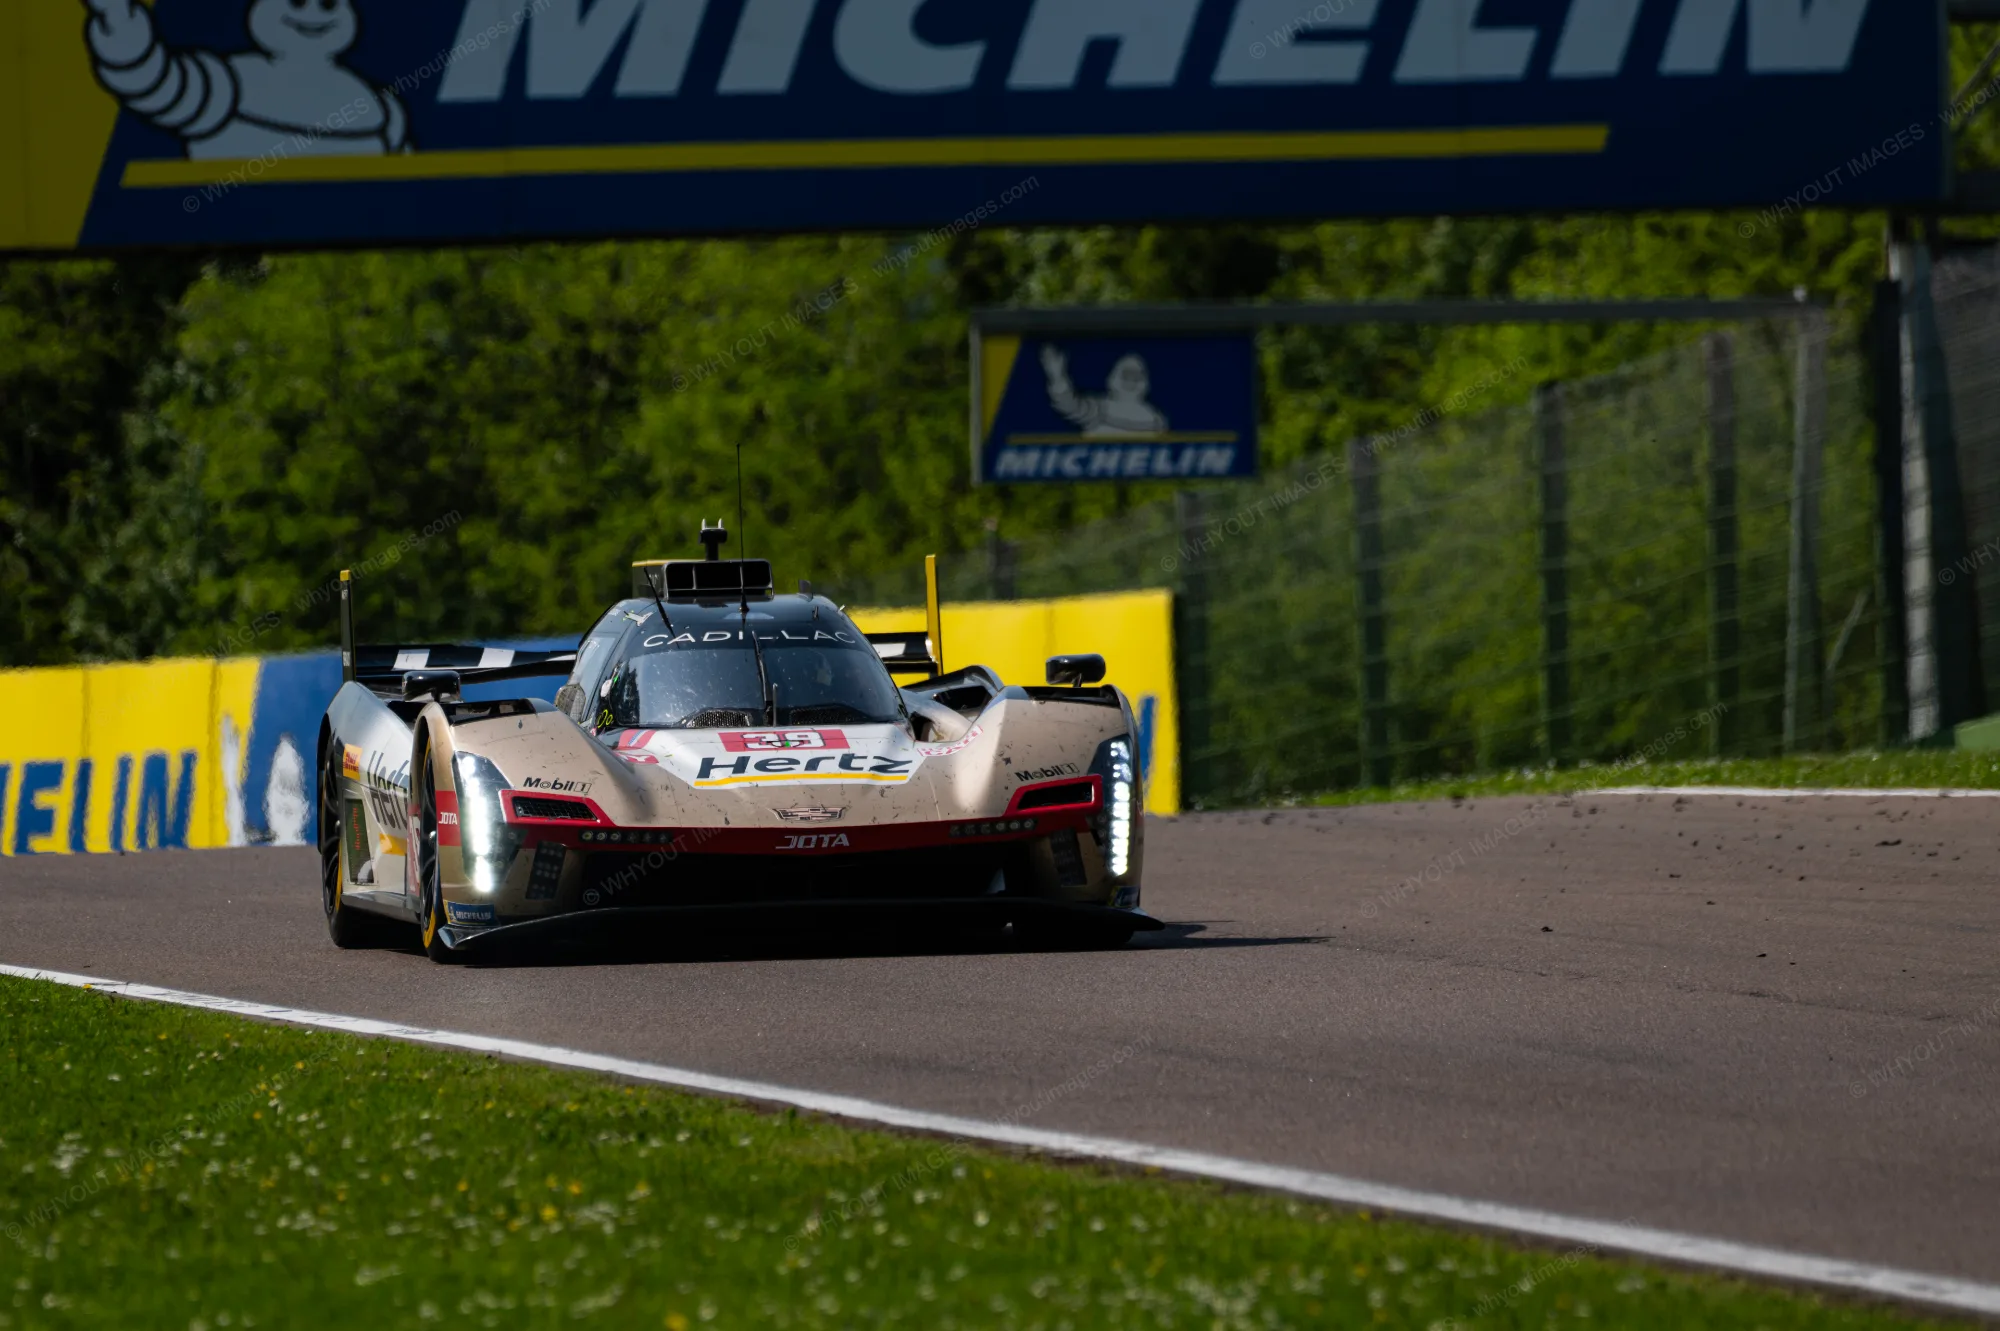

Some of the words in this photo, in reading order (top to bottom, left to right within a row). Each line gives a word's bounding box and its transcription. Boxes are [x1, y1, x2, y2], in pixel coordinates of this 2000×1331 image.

[994, 446, 1236, 478] MICHELIN
[696, 753, 913, 779] Hertz
[1014, 765, 1065, 781] Mobil
[523, 777, 574, 791] Mobil
[438, 811, 458, 825] JOTA
[775, 833, 850, 849] JOTA
